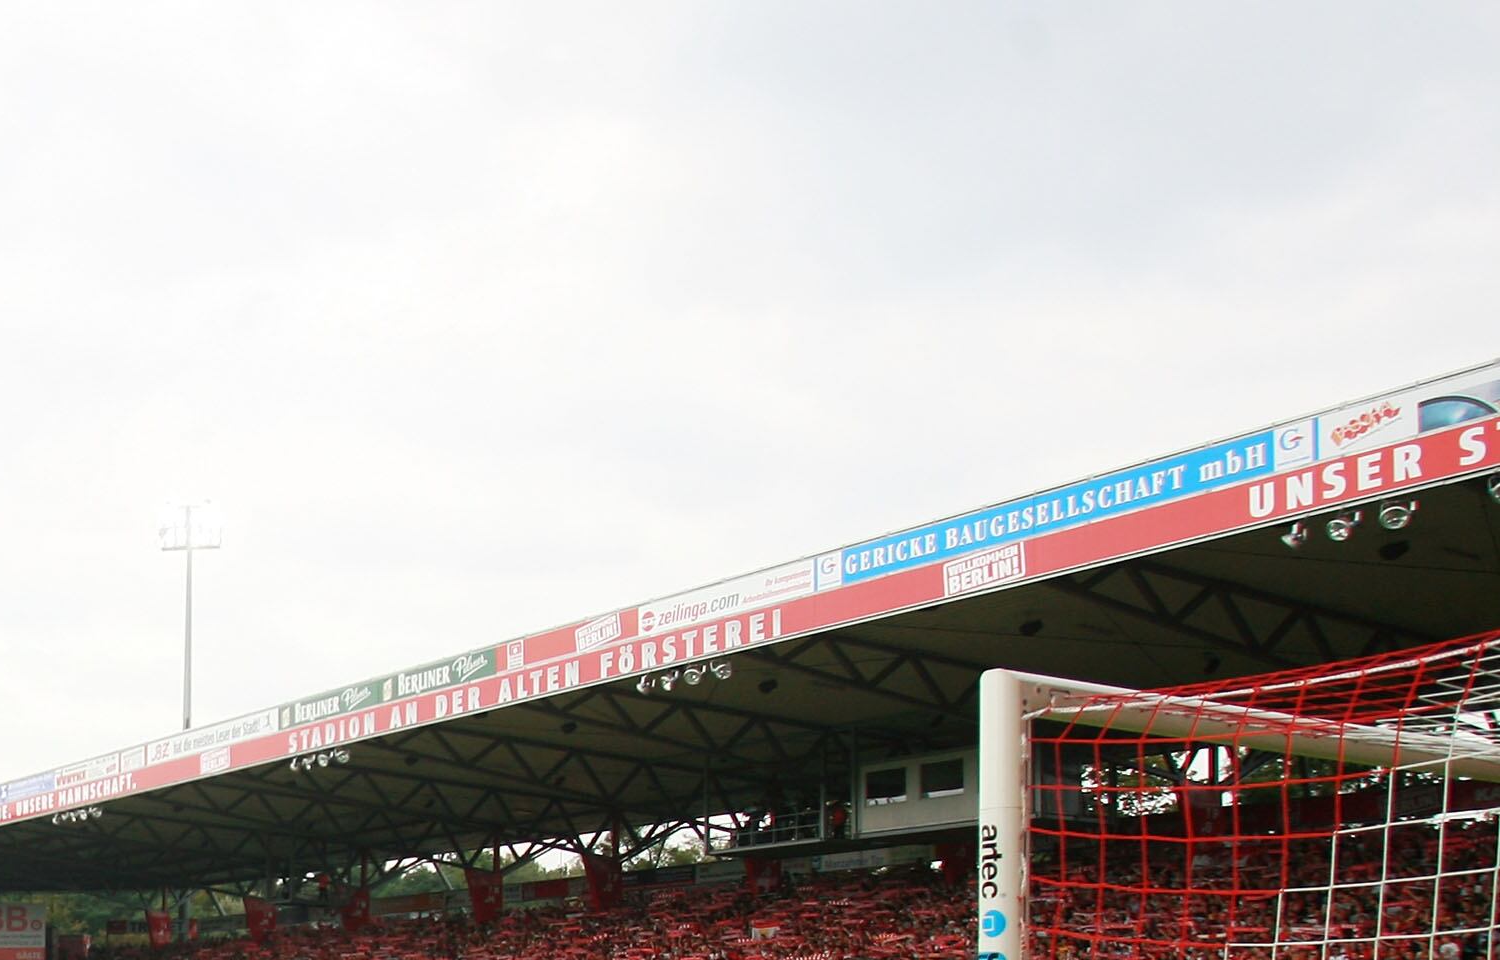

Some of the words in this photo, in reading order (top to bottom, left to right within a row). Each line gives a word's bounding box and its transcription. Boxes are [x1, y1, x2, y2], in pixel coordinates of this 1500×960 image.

[1249, 444, 1422, 518] UNSER
[845, 533, 936, 574] GERICKE
[944, 466, 1186, 548] BAUGESELLSCHAFT
[1199, 442, 1267, 482] mbH
[947, 544, 1019, 575] WILLKOMMEN
[948, 560, 1021, 598] BERLIN!
[658, 592, 740, 625] zeilinga.com
[580, 622, 618, 650] BERLIN!
[288, 715, 376, 754] STADION
[390, 702, 417, 728] AN
[436, 686, 480, 716] DER
[498, 660, 580, 702] ALTEN
[600, 608, 782, 679] FÖRSTEREI
[398, 664, 450, 697] BERLINER
[294, 695, 340, 724] BERLINER
[16, 793, 54, 817] UNSERE
[58, 773, 137, 808] MANNSCHAFT.
[982, 825, 1002, 900] artec
